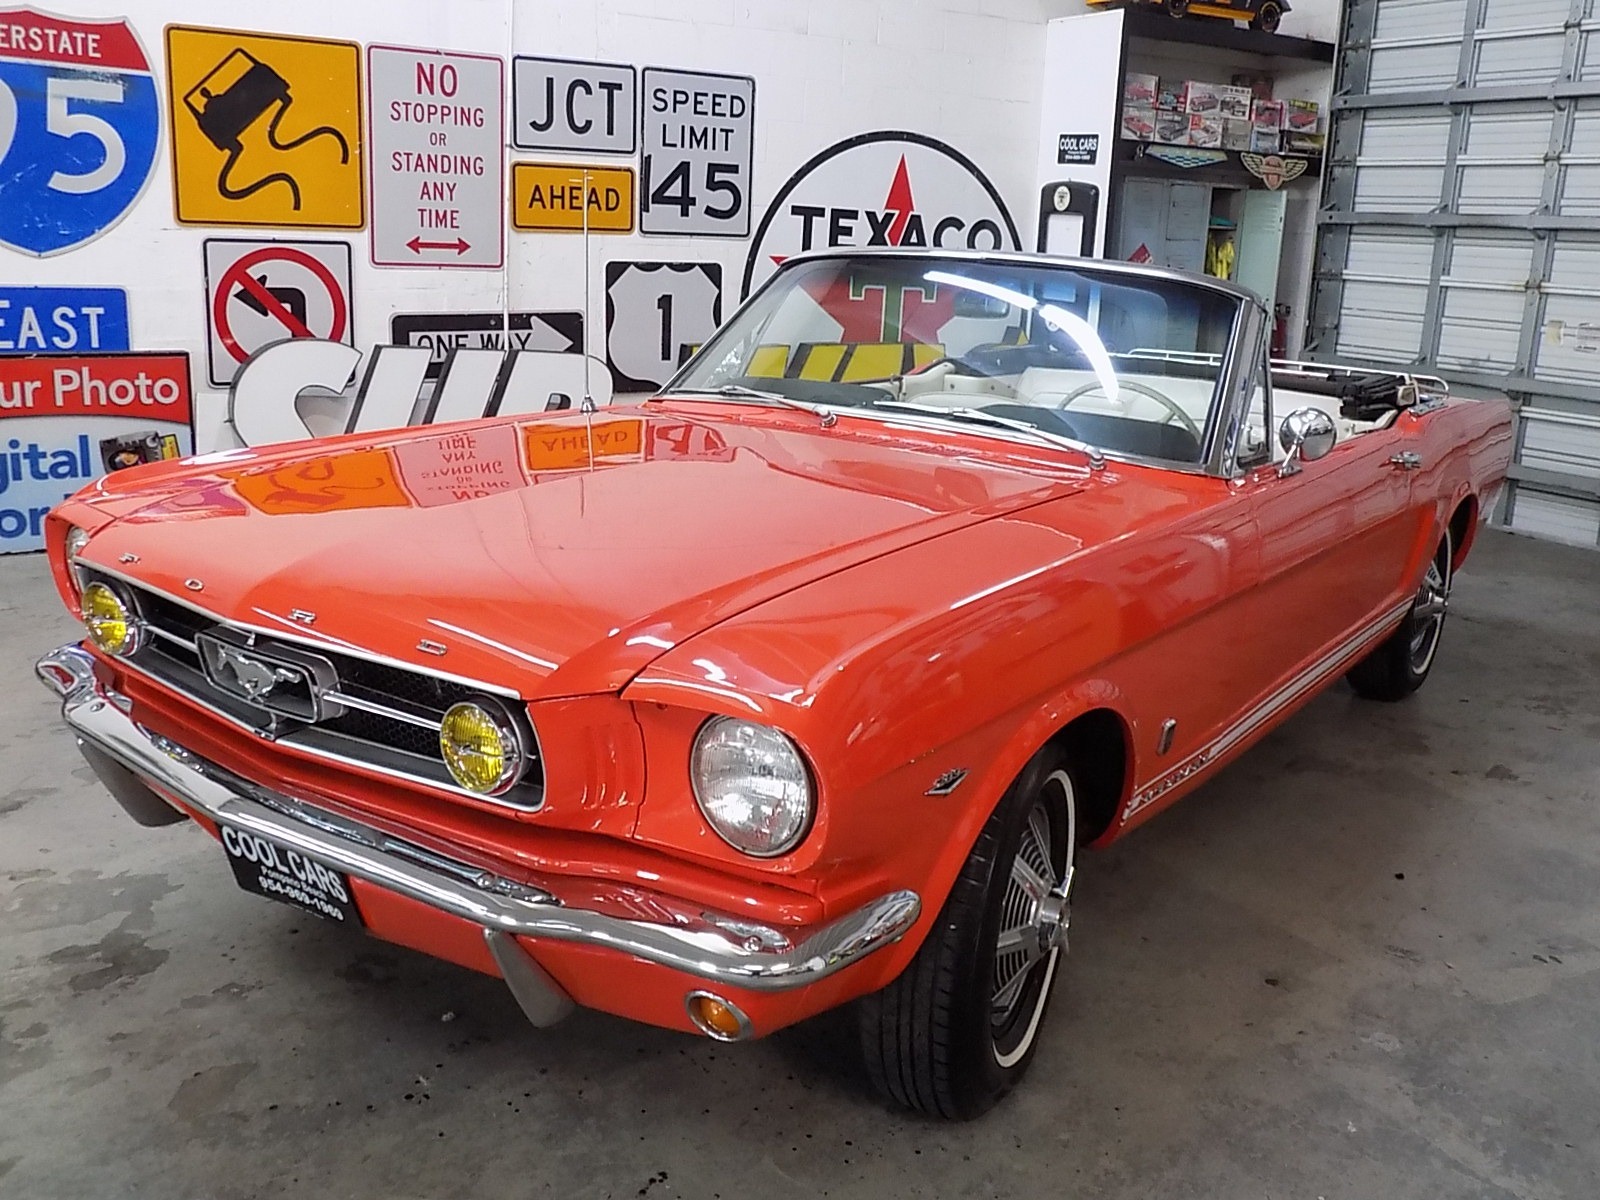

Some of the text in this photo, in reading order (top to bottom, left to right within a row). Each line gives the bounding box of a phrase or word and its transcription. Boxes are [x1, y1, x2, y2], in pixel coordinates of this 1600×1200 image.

[416, 62, 458, 97] NO
[390, 101, 484, 128] STOPPING
[529, 77, 622, 136] JCT
[652, 88, 746, 118] SPEED
[0, 78, 126, 194] 5
[429, 132, 447, 146] OR
[662, 123, 735, 151] LIMIT
[1060, 136, 1097, 151] COOL CARS
[391, 151, 484, 176] STANDING
[420, 181, 457, 202] ANY
[528, 184, 620, 212] AHEAD
[418, 208, 460, 229] TIME
[791, 205, 1001, 251] TEXACO
[657, 295, 673, 361] 1
[53, 366, 180, 408] Photo
[222, 825, 349, 903] COOL CARS
